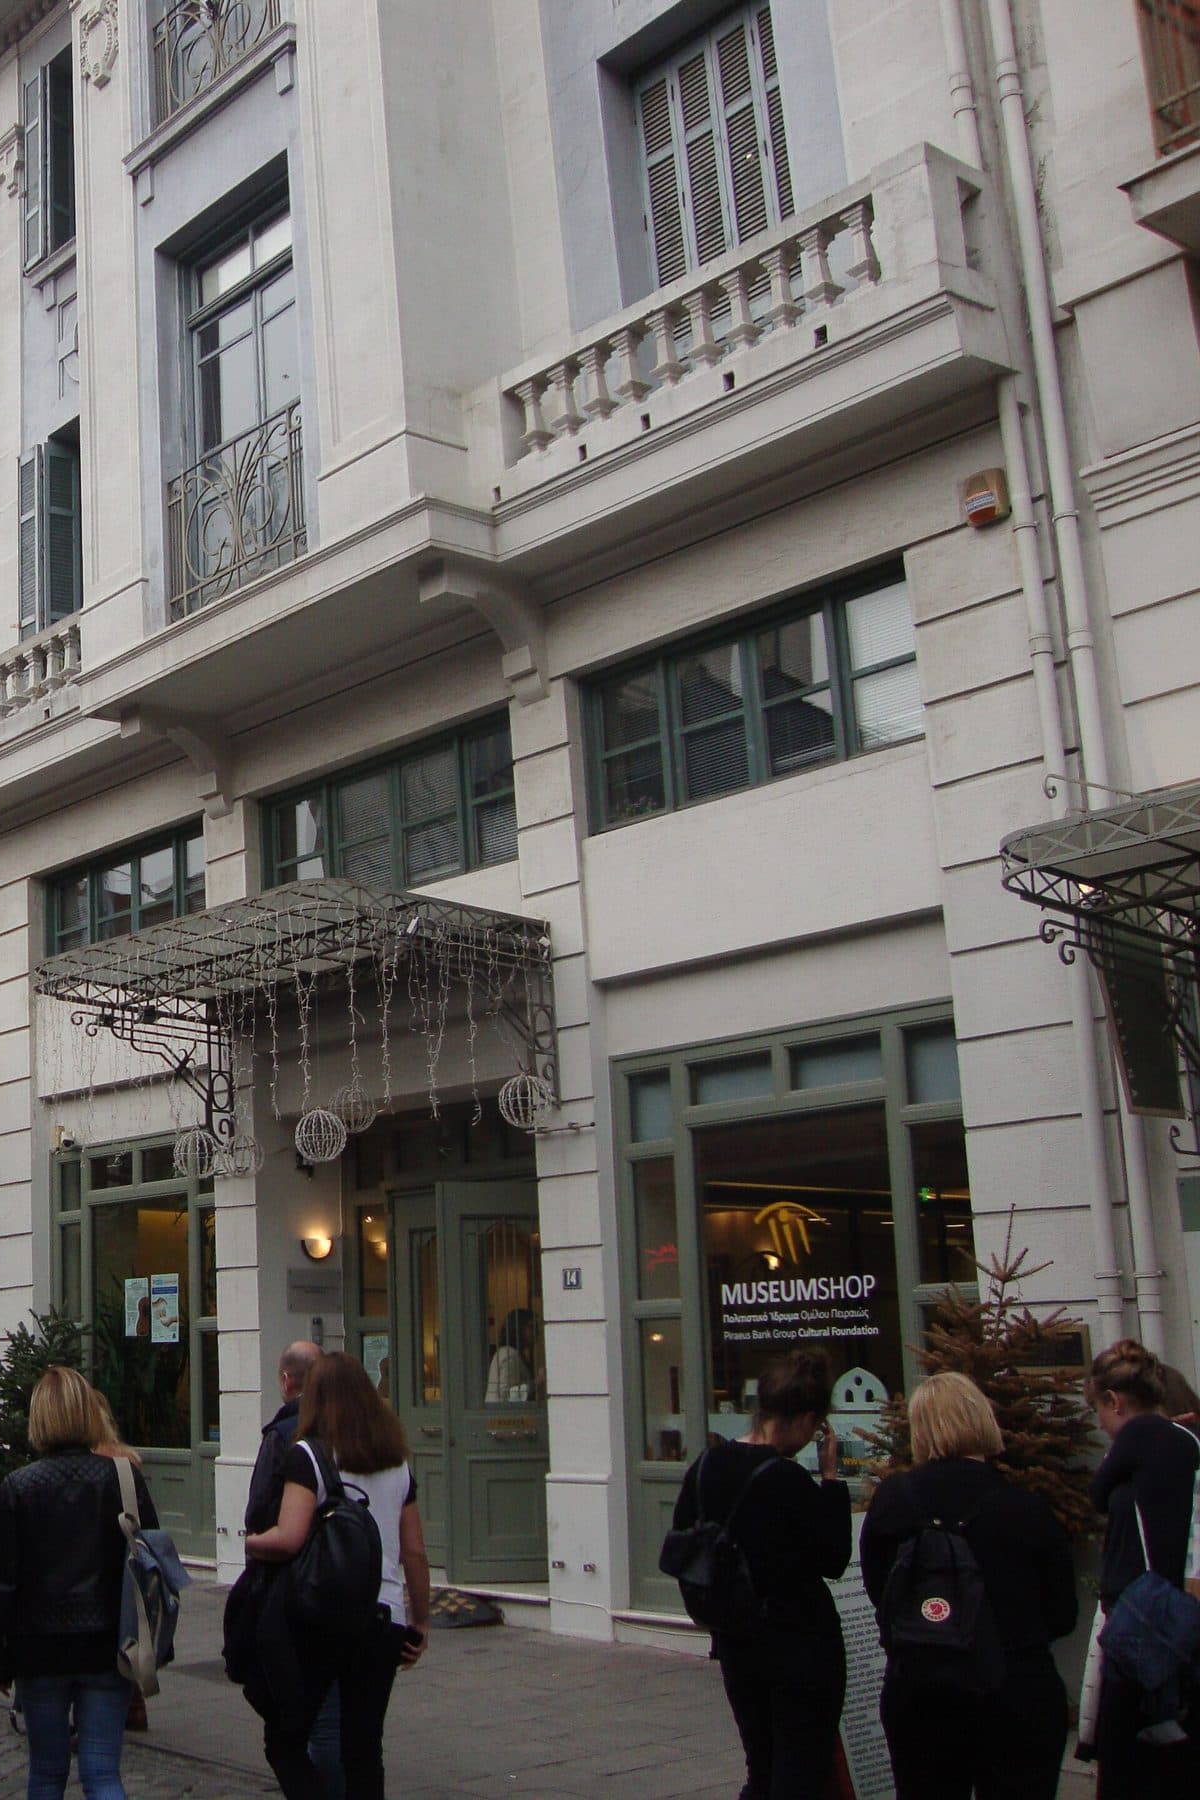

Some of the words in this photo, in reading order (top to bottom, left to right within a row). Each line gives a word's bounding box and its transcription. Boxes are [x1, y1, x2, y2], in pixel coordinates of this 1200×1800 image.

[566, 1271, 577, 1286] 14
[721, 1274, 876, 1306] MUSEUMSHOP
[752, 1329, 772, 1340] Bank
[773, 1328, 798, 1340] Group
[798, 1326, 830, 1338] Cultural
[831, 1325, 879, 1337] Foundation
